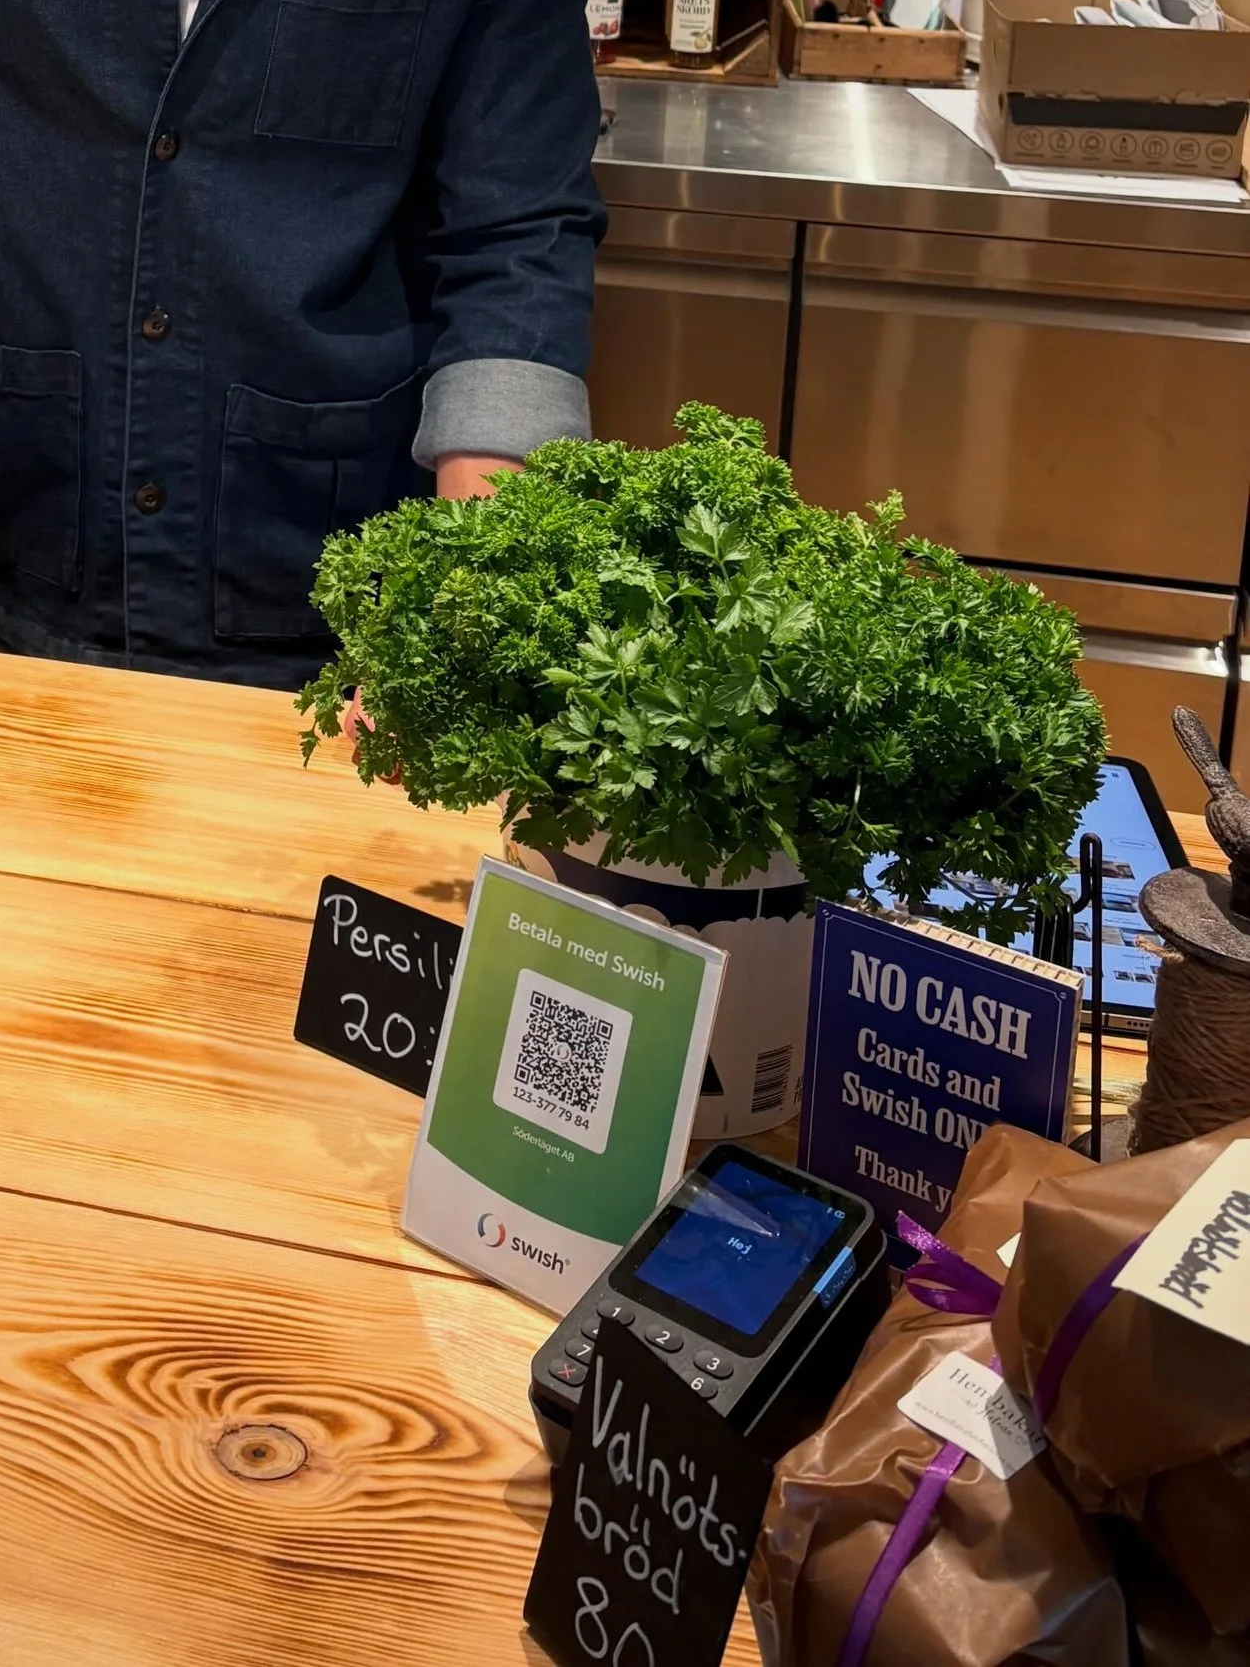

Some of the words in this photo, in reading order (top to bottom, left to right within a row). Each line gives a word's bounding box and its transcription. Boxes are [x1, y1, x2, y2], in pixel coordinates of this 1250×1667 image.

[508, 912, 562, 948] Betala
[566, 939, 608, 967] med
[611, 955, 665, 992] Swish
[848, 950, 907, 1012] NO
[916, 976, 1032, 1059] CASH
[857, 1027, 940, 1088] Cards
[945, 1069, 1000, 1112] and
[513, 1087, 557, 1113] 123-377
[558, 1107, 572, 1121] 79
[574, 1115, 590, 1130] 84
[842, 1071, 928, 1135] Swish
[561, 1150, 575, 1162] AB
[854, 1145, 932, 1203] Thank
[511, 1237, 564, 1275] swish
[727, 1237, 753, 1255] Hej
[611, 1307, 622, 1317] 1
[577, 1344, 591, 1357] 7
[655, 1331, 671, 1345] 2
[706, 1357, 721, 1371] 3
[690, 1377, 705, 1391] 6
[574, 1462, 684, 1615] bröd
